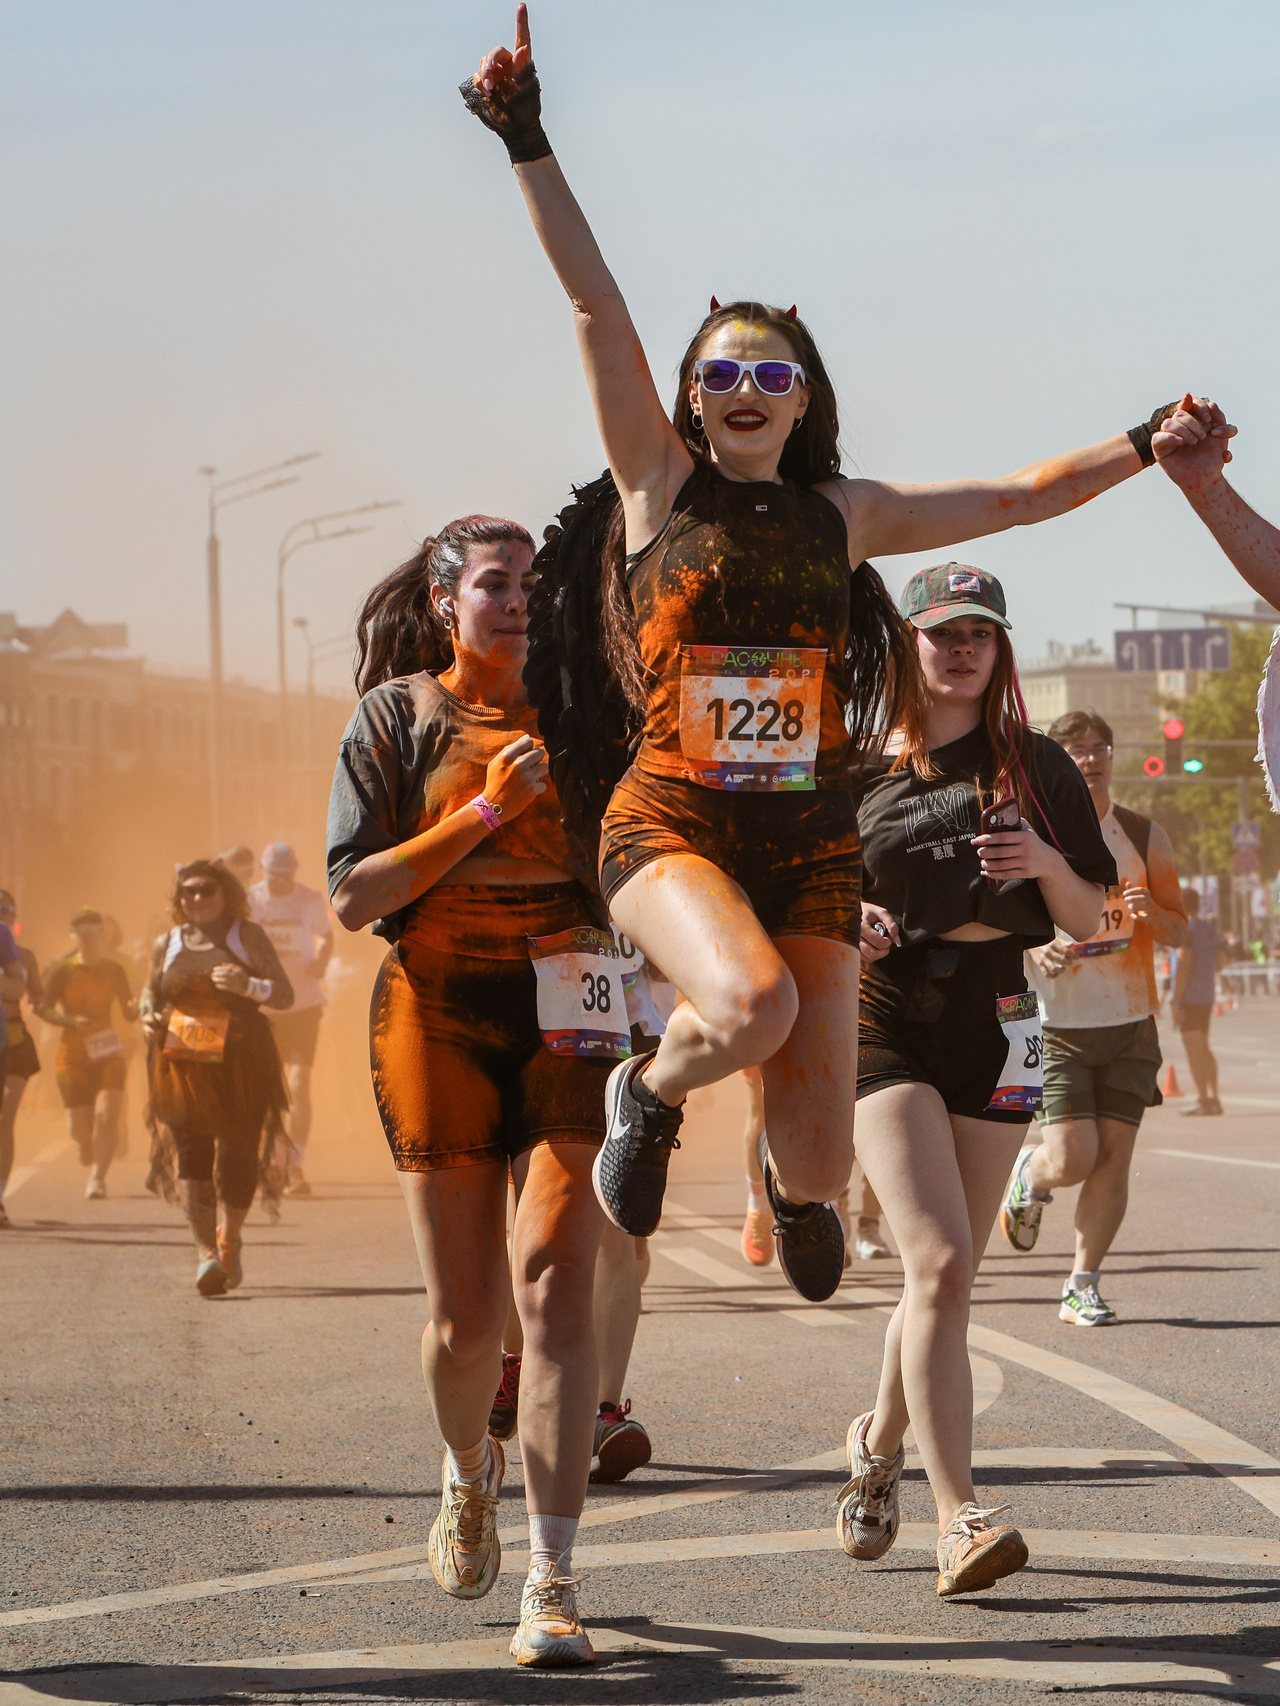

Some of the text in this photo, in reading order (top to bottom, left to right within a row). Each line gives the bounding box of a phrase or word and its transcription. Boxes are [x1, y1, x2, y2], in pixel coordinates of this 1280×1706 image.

[695, 651, 816, 668] КРАСОЧНЫ
[707, 698, 805, 742] 1228
[899, 787, 970, 843] TOKYO
[906, 833, 976, 854] BASKETBALL EAST JAPAN
[581, 971, 611, 1014] 38
[1023, 1035, 1044, 1070] 89
